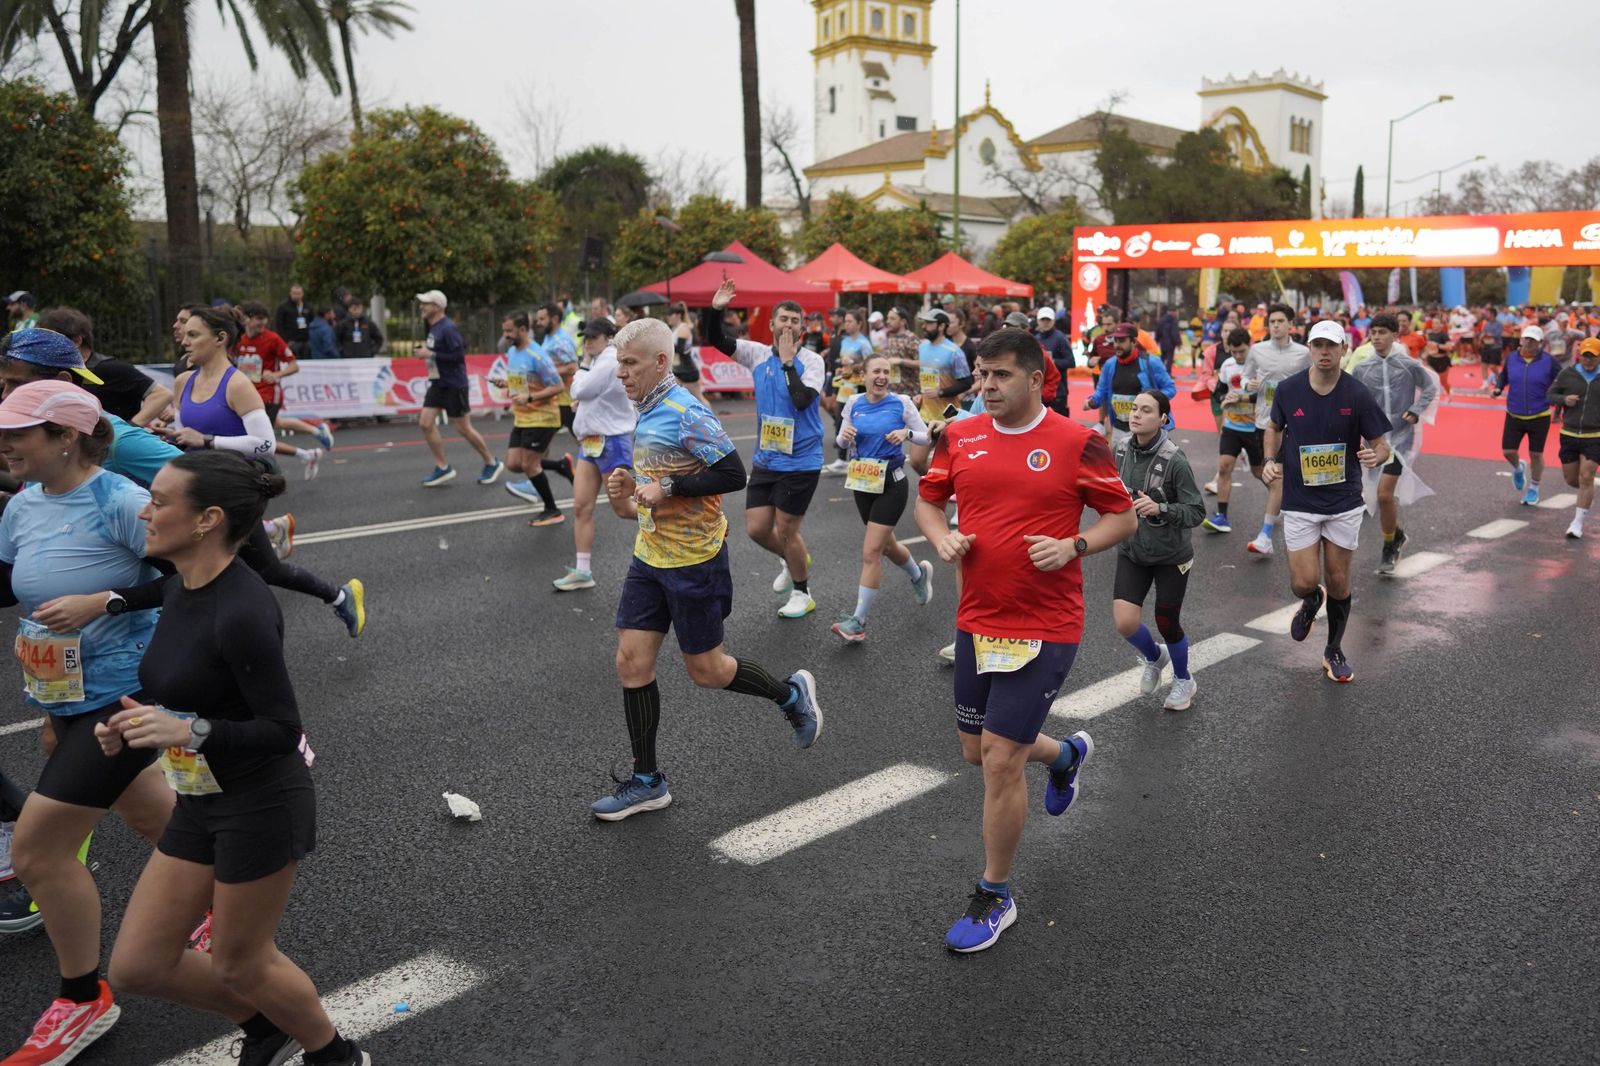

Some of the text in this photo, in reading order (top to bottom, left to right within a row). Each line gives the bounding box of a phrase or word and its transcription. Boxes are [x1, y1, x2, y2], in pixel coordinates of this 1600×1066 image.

[1504, 229, 1563, 248] HOKA
[282, 382, 359, 402] CREATE
[763, 425, 786, 437] 17431
[1305, 454, 1339, 468] 16640
[852, 463, 880, 476] 14788
[957, 704, 977, 713] CLUB
